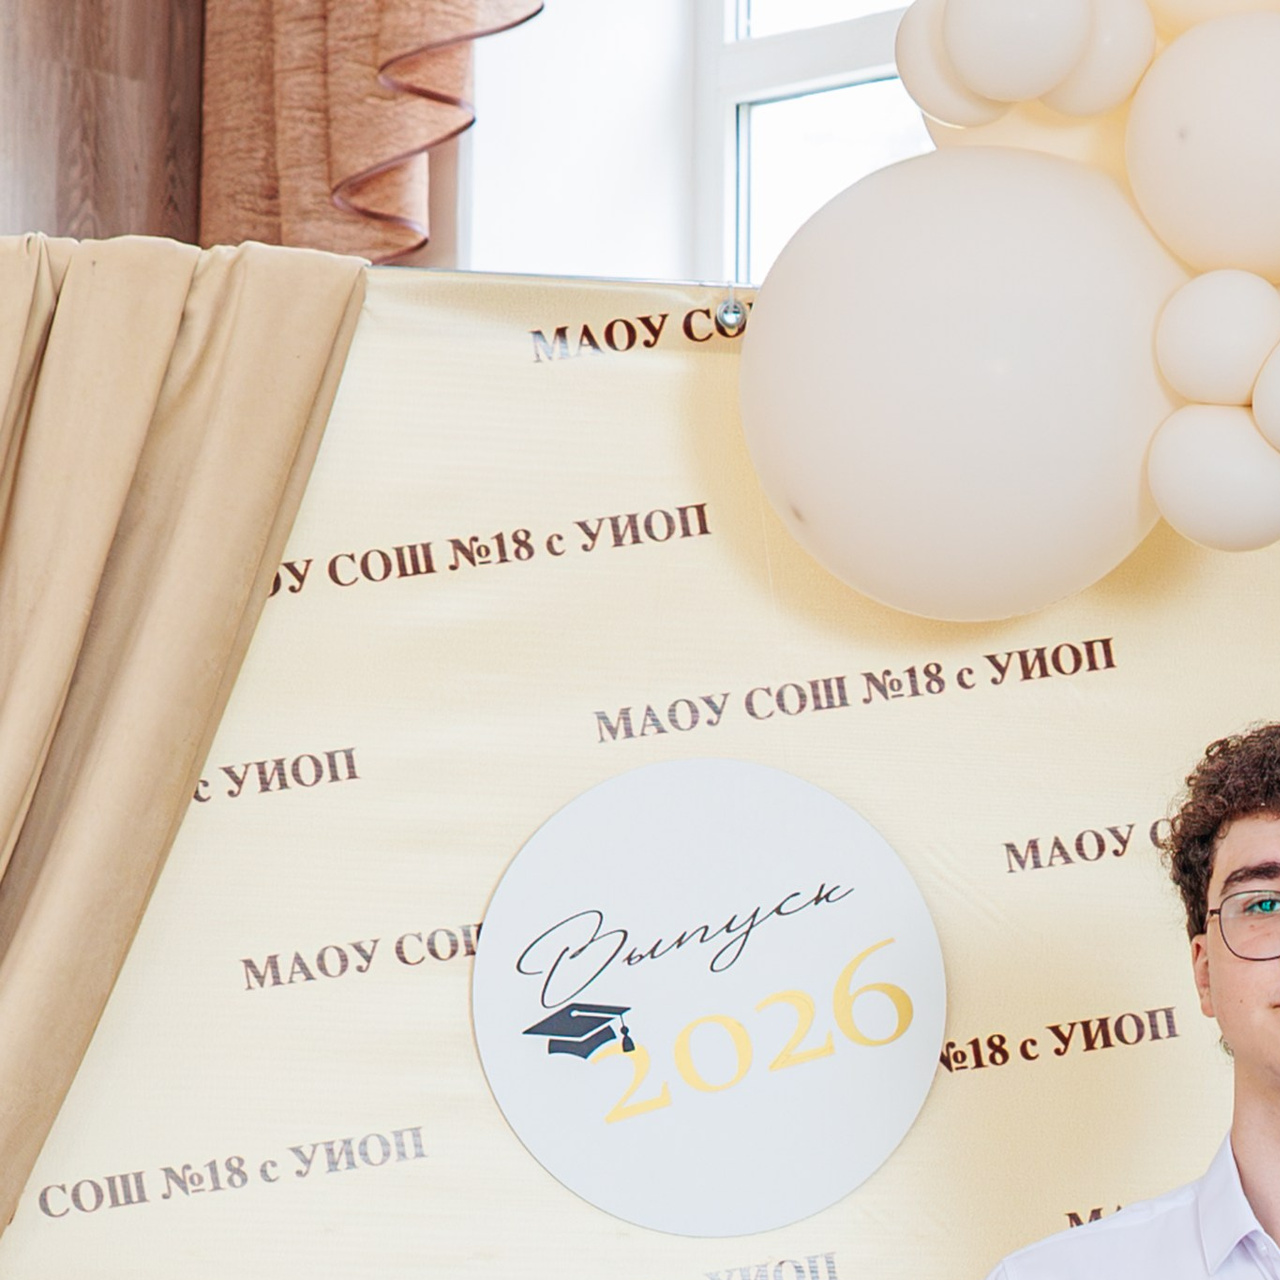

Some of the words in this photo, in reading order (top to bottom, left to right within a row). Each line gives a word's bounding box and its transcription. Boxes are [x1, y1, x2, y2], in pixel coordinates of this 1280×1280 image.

[531, 312, 668, 363] МАОУ
[327, 542, 437, 587] СОШ
[447, 528, 535, 571] №18
[544, 532, 566, 558] с
[574, 502, 712, 553] УИОП
[594, 692, 731, 744] МАОУ
[744, 675, 850, 720] СОШ
[861, 662, 946, 705] №18
[955, 666, 977, 691] с
[983, 637, 1116, 686] УИОП
[219, 747, 360, 798] УИОП
[1003, 823, 1135, 874] МАОУ
[241, 938, 380, 991] МАОУ
[515, 882, 854, 1009] Выпуск
[590, 937, 915, 1124] 2026
[939, 1033, 1010, 1073] №18
[1018, 1037, 1041, 1062] с
[1046, 1007, 1179, 1057] УИОП
[38, 1170, 149, 1218] СОШ
[160, 1155, 249, 1200] №18
[258, 1158, 281, 1184] с
[287, 1126, 428, 1178] УИОП
